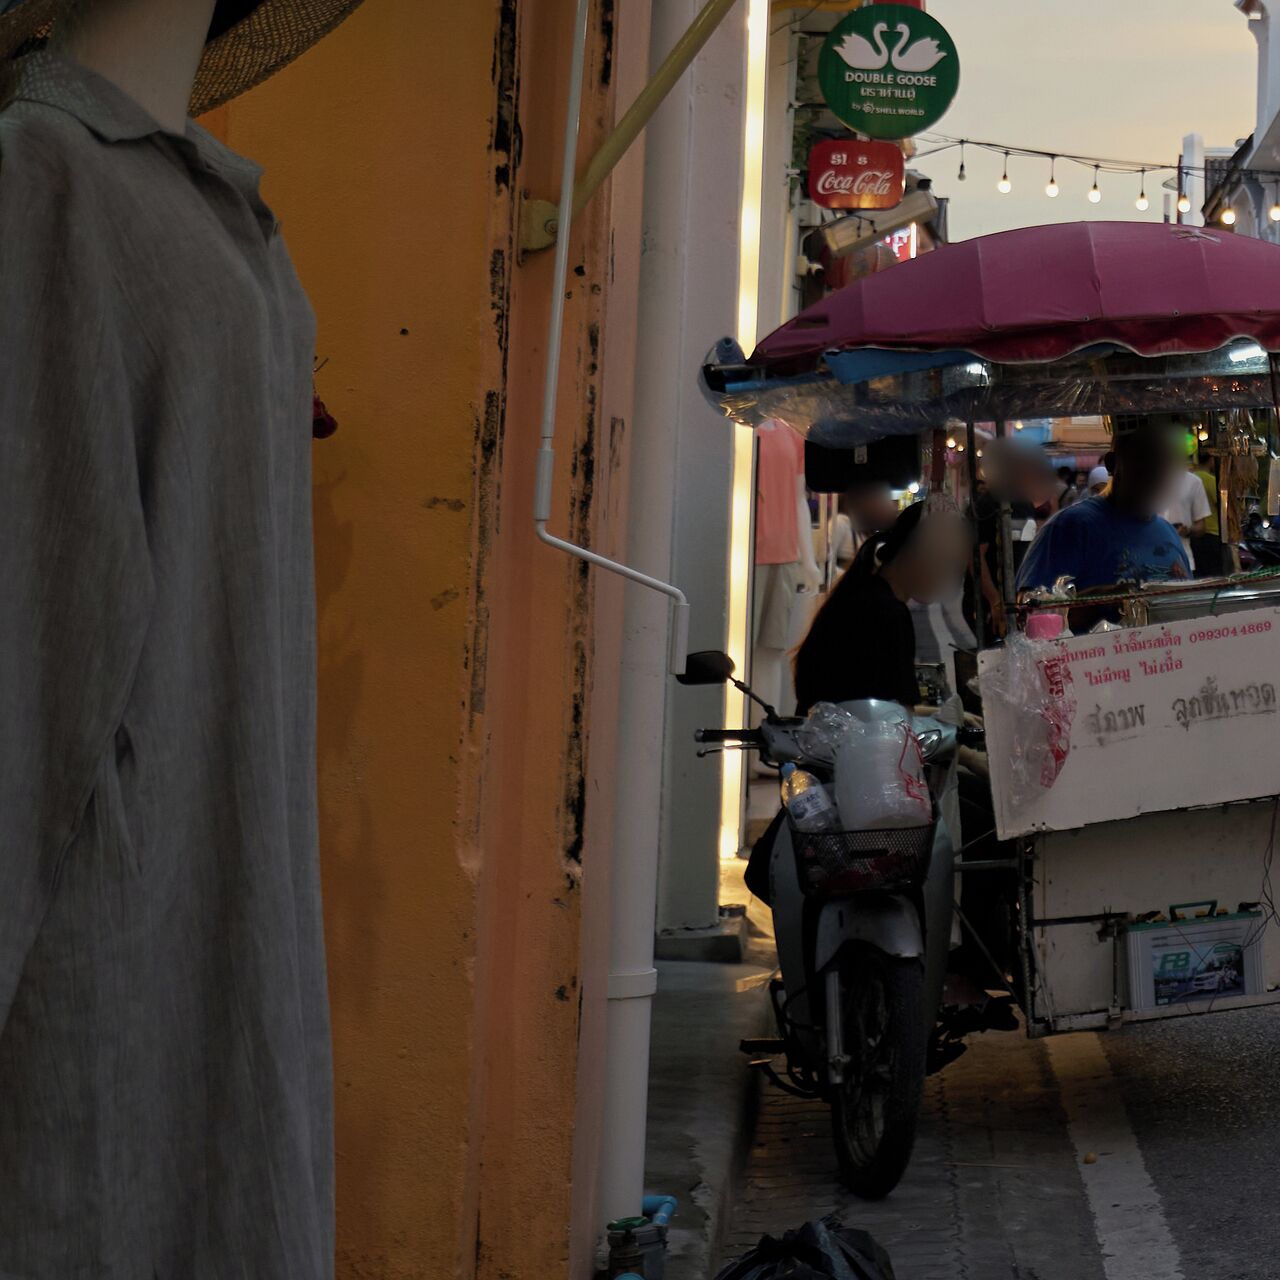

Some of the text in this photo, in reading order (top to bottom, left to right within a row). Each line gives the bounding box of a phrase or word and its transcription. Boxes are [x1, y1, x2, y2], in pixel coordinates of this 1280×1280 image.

[844, 72, 937, 87] DOUBLE GOOSE
[1189, 621, 1272, 643] 0993044869
